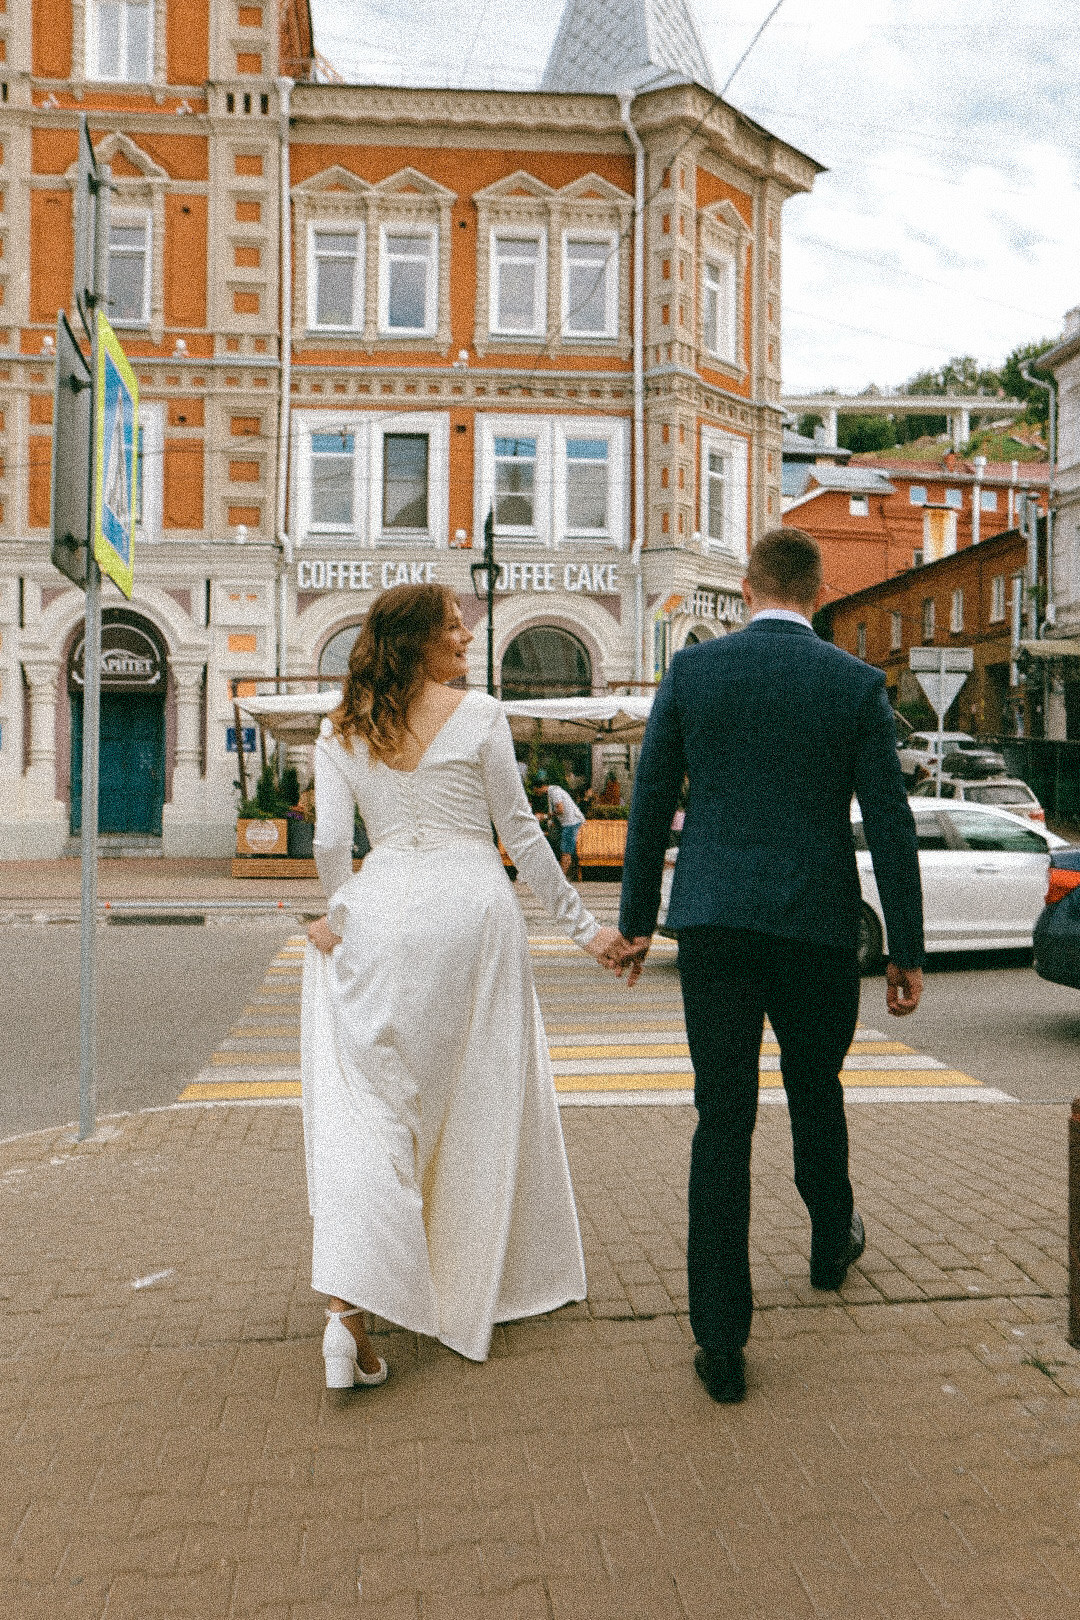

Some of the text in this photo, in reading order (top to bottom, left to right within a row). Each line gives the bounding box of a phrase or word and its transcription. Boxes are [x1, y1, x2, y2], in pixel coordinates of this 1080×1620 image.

[297, 560, 438, 590] COFFEE CAKE
[563, 562, 619, 592] CAKE
